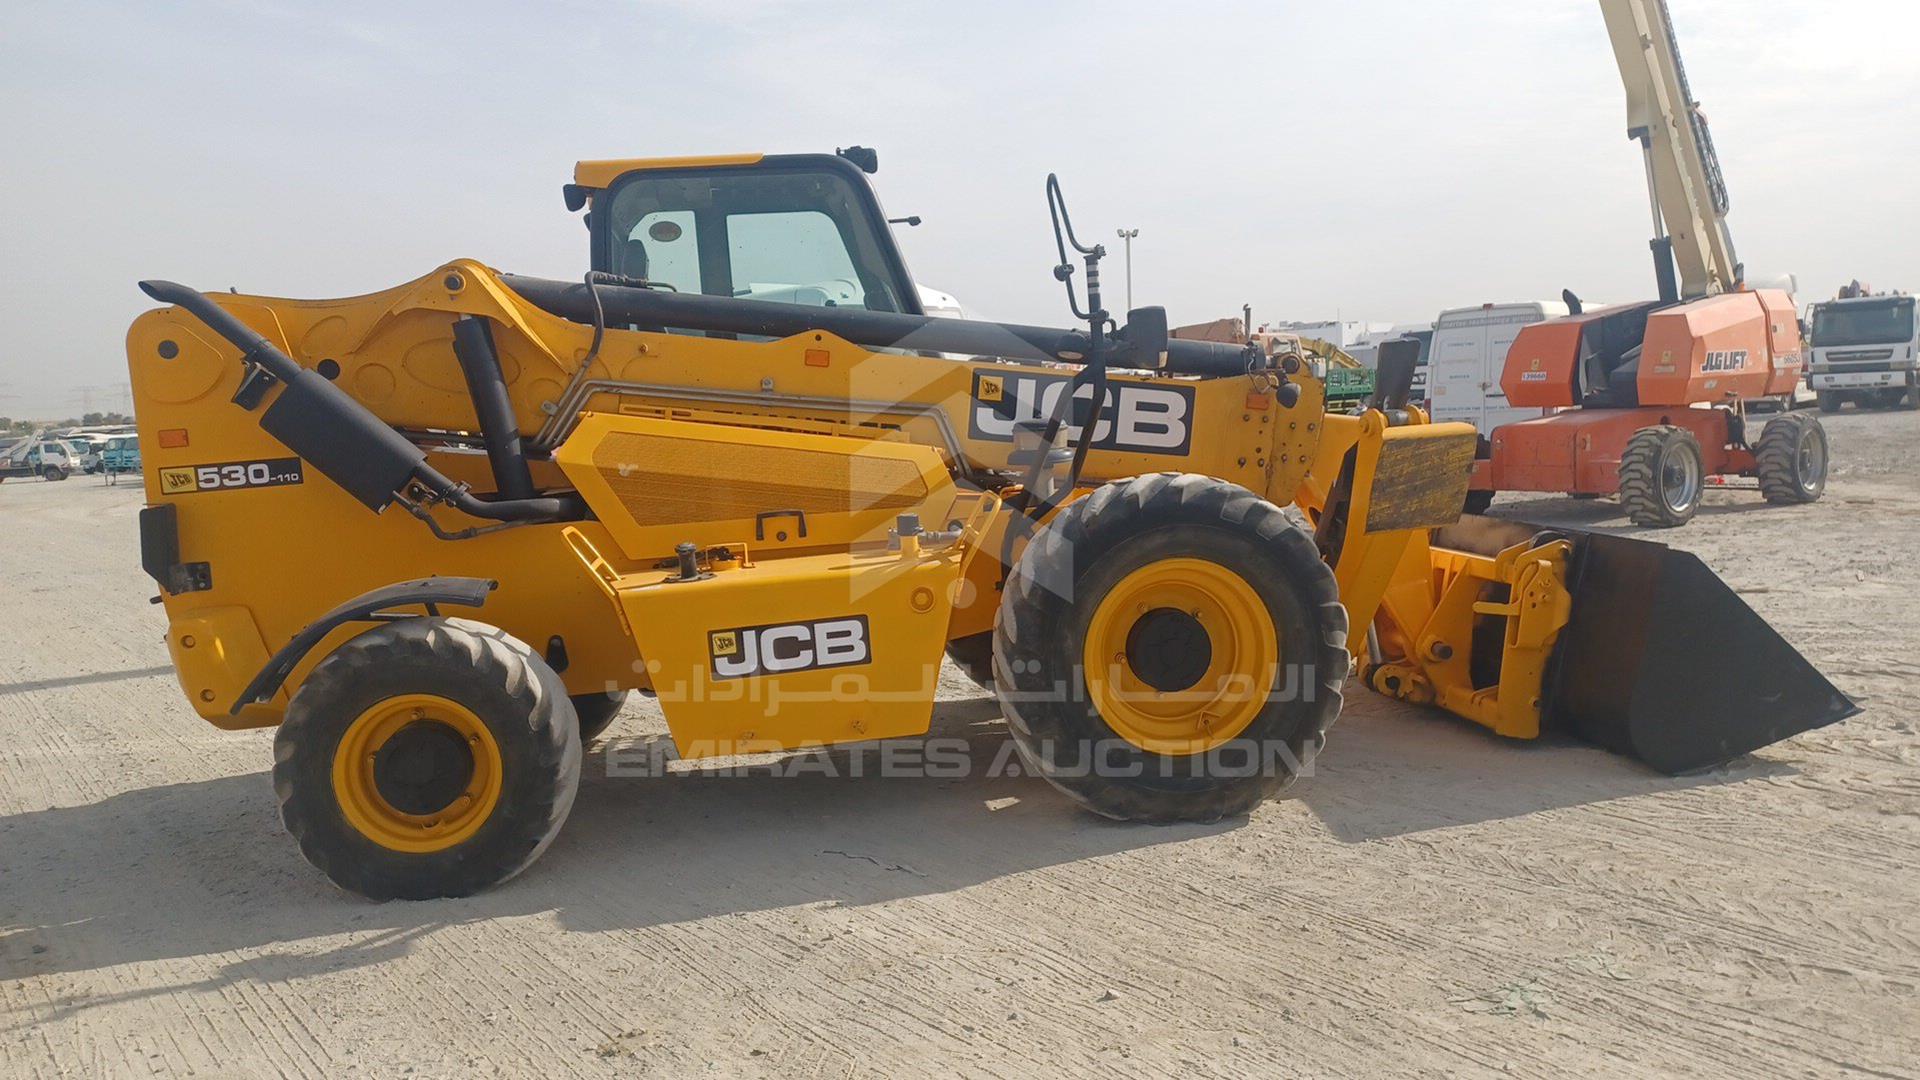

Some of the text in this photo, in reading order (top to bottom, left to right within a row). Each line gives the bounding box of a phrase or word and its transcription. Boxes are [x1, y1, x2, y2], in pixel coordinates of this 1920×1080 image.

[1702, 351, 1747, 371] JLG LIFT
[976, 378, 1187, 448] JCB
[166, 472, 192, 488] JCB
[715, 619, 867, 676] JCB
